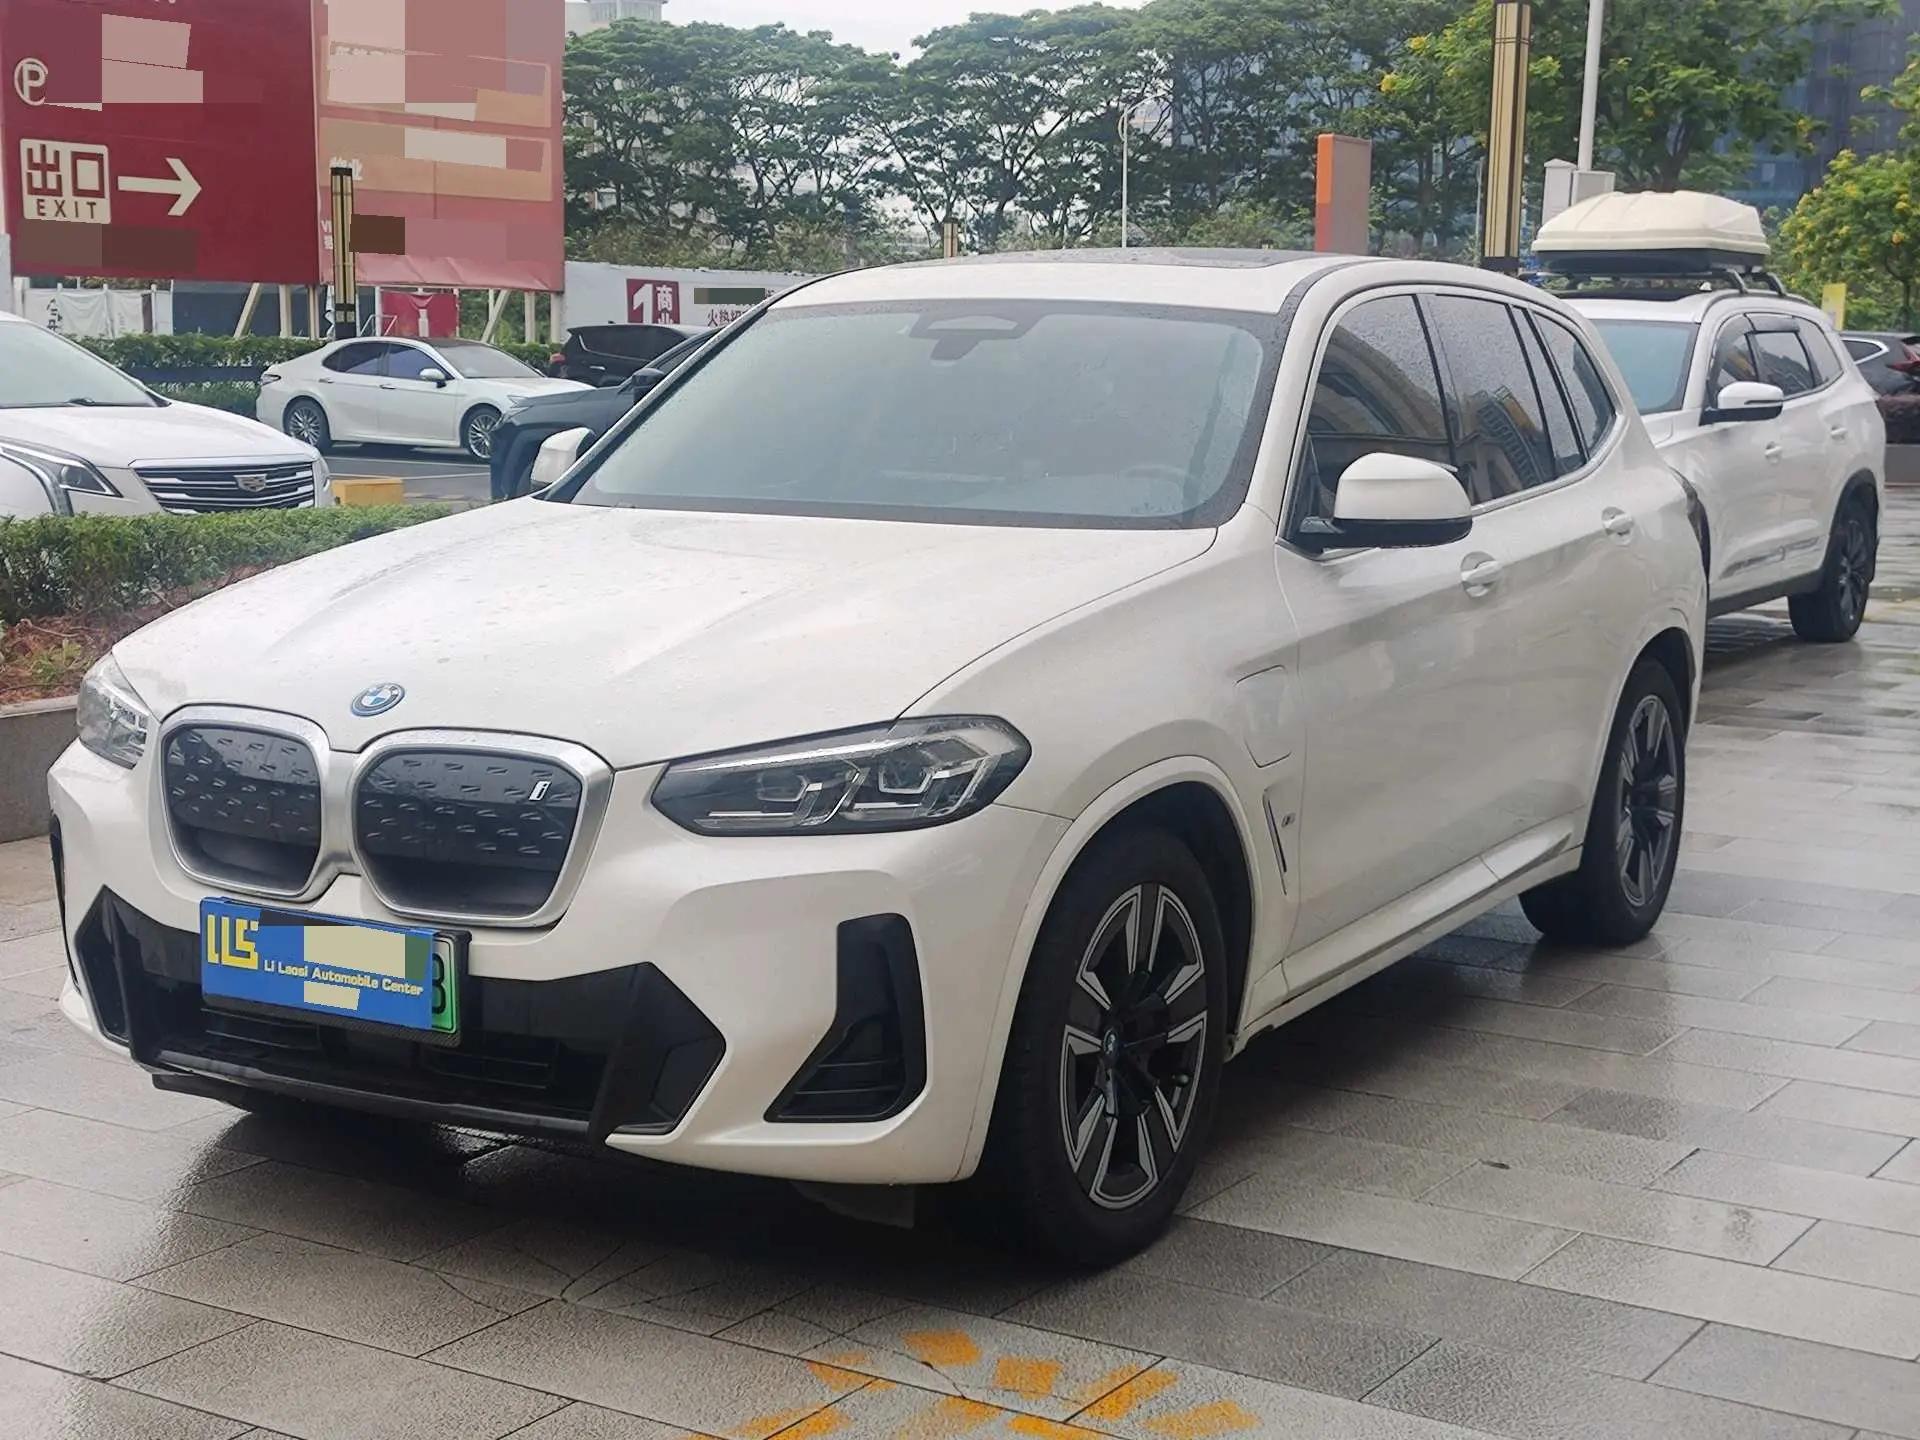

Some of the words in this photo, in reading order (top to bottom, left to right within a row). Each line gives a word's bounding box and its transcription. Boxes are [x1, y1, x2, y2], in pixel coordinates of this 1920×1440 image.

[22, 63, 46, 99] P
[26, 144, 106, 199] 出口
[36, 199, 97, 220] EXIT
[278, 961, 308, 977] Laosi
[312, 967, 379, 989] Automobile
[382, 978, 424, 996] Center
